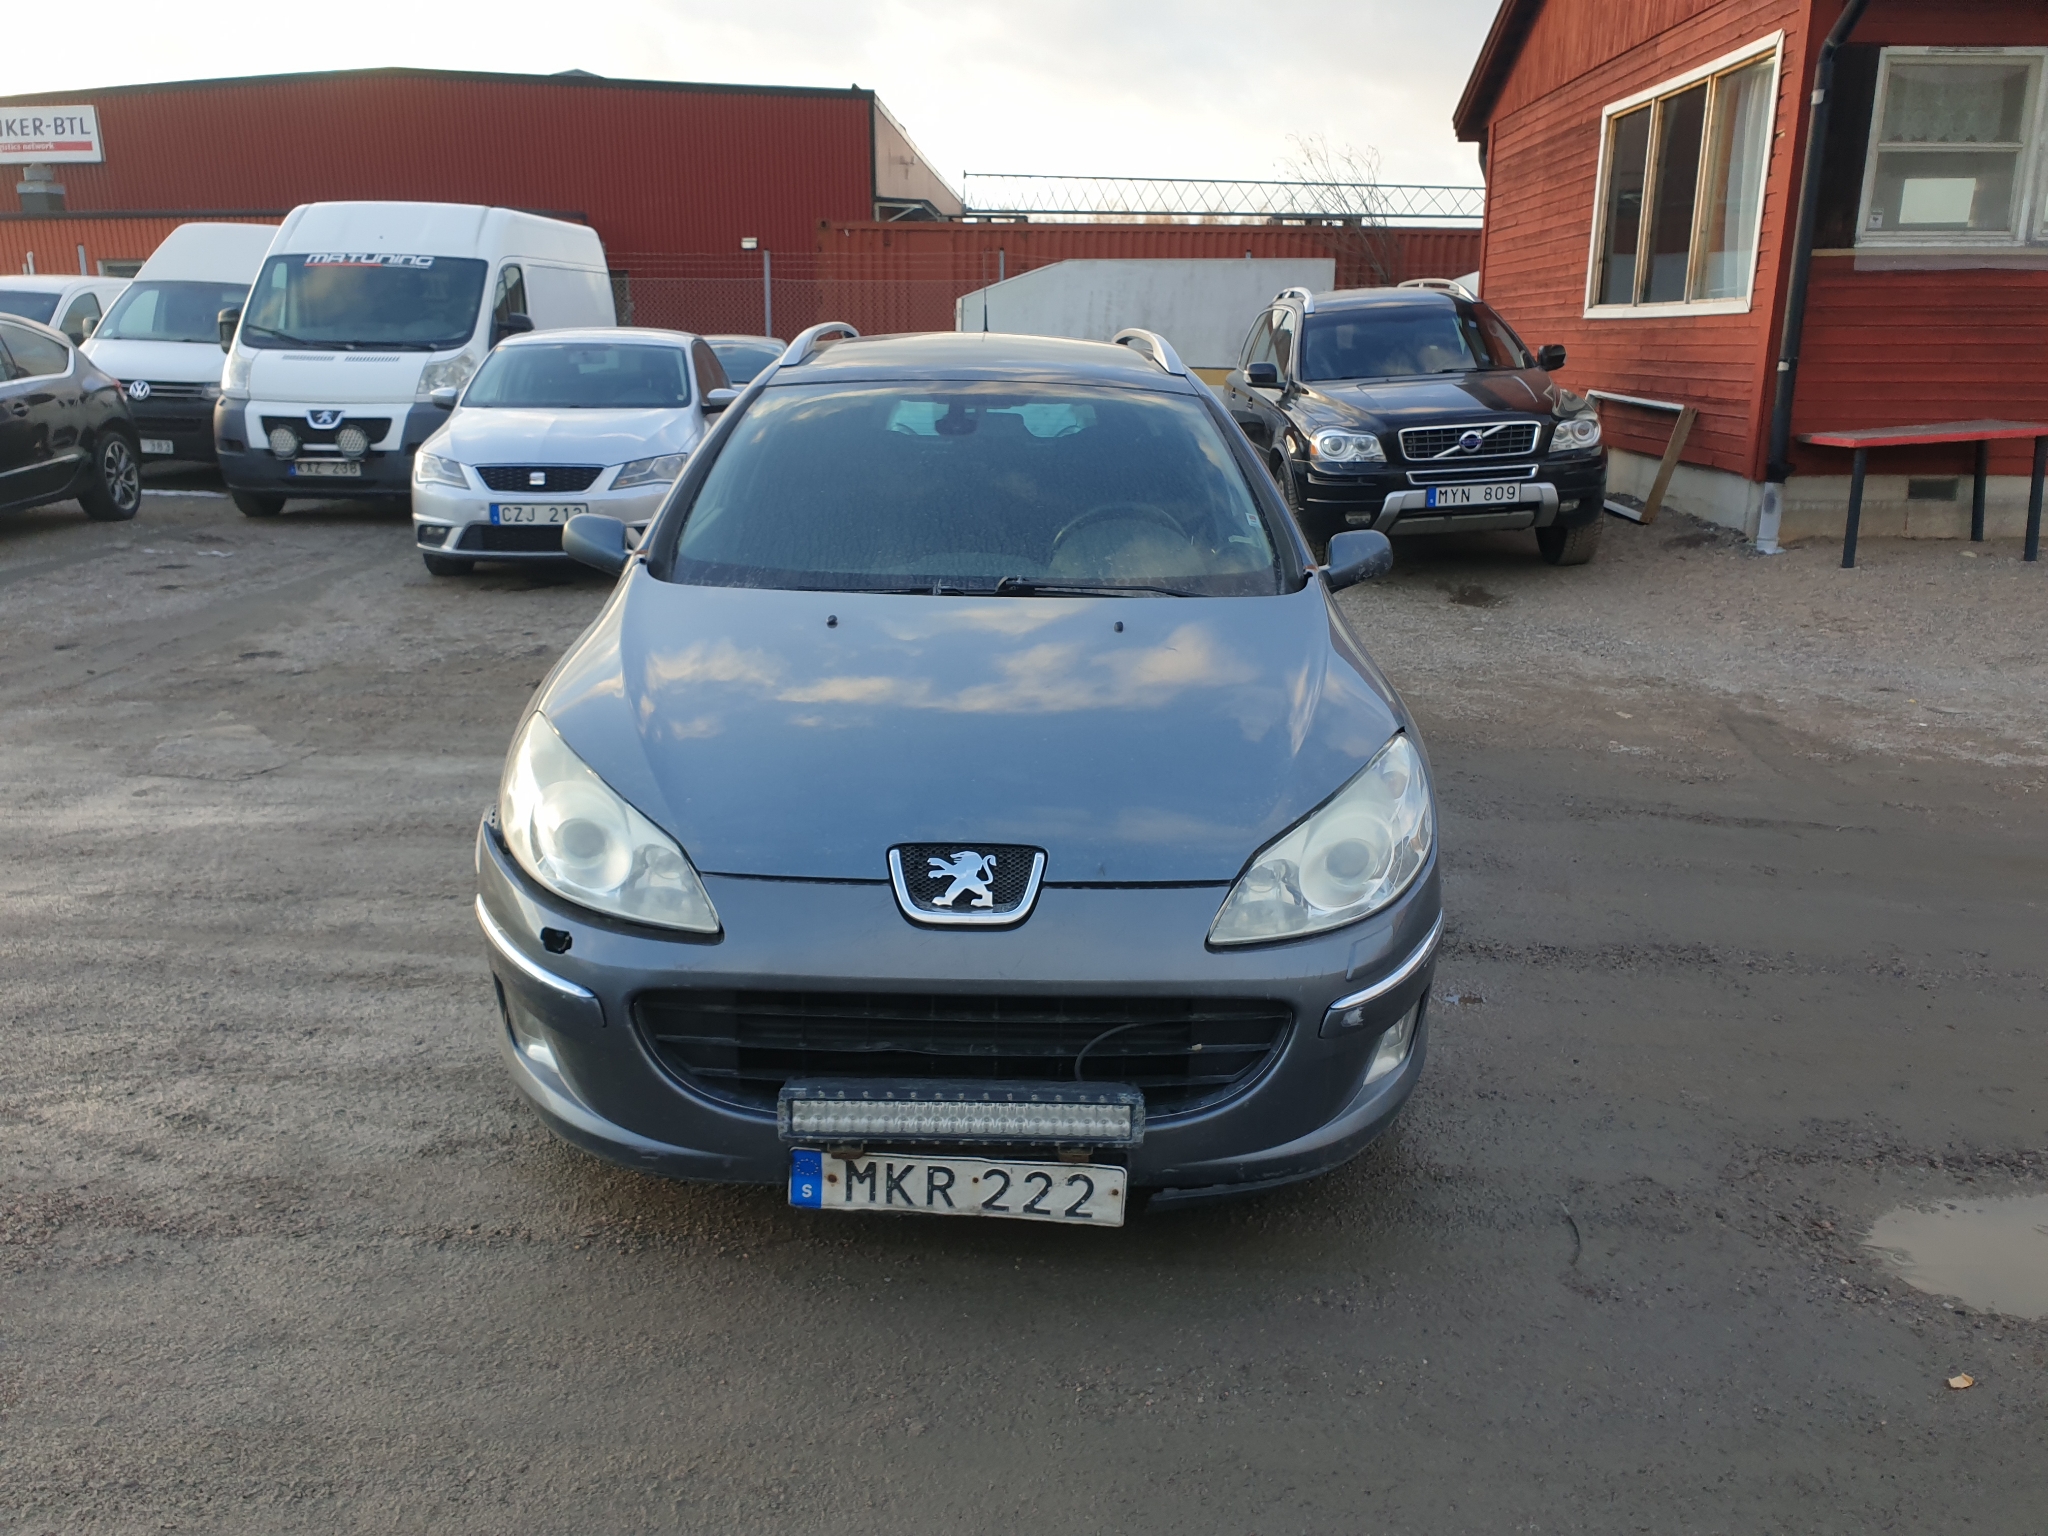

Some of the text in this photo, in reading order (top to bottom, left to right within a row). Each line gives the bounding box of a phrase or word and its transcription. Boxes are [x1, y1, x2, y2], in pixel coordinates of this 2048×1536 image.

[1438, 486, 1516, 504] MYN 809
[502, 507, 535, 522] CZJ
[802, 1184, 812, 1198] S
[845, 1160, 1094, 1218] MKR 222
